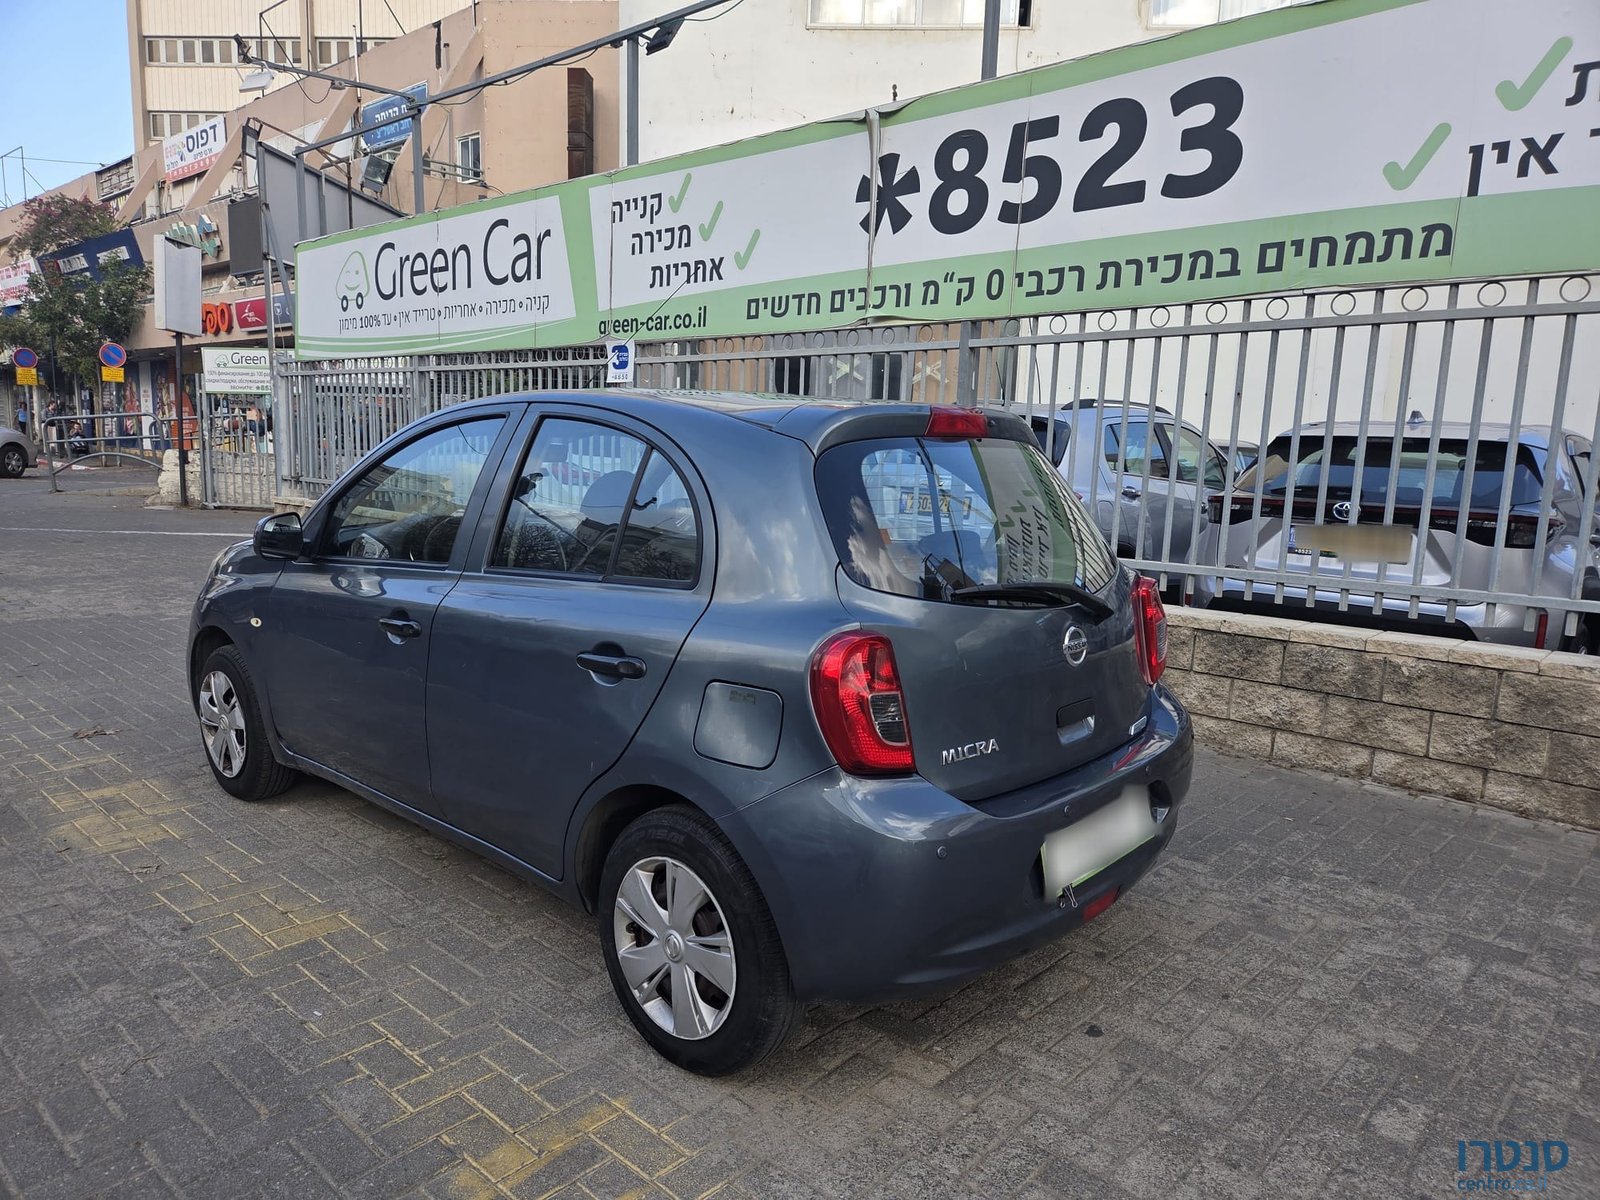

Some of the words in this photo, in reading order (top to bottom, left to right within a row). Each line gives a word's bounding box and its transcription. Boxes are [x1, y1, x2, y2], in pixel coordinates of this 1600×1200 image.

[185, 123, 218, 153] דפוס
[1467, 132, 1565, 197] אין
[612, 192, 662, 224] קנייה
[631, 224, 691, 255] מכירה
[1257, 222, 1454, 275] מתמחים
[374, 241, 472, 301] Green
[483, 218, 551, 286] Car
[649, 256, 724, 288] אחריות
[1096, 246, 1240, 290] במכירת
[986, 268, 1004, 301] 0
[1016, 264, 1085, 298] רכבי
[443, 303, 477, 319] אחריות
[486, 298, 516, 316] מכירה
[526, 294, 549, 315] קניה
[746, 291, 821, 320] חדשים
[830, 282, 911, 313] ורכבים
[339, 317, 357, 334] מימון
[360, 314, 381, 329] 100%
[382, 313, 392, 326] עד
[399, 311, 410, 328] אין
[413, 308, 435, 321] טרייד
[598, 305, 707, 335] green-car.co.il
[231, 352, 267, 365] Green
[941, 738, 1000, 767] MICRA
